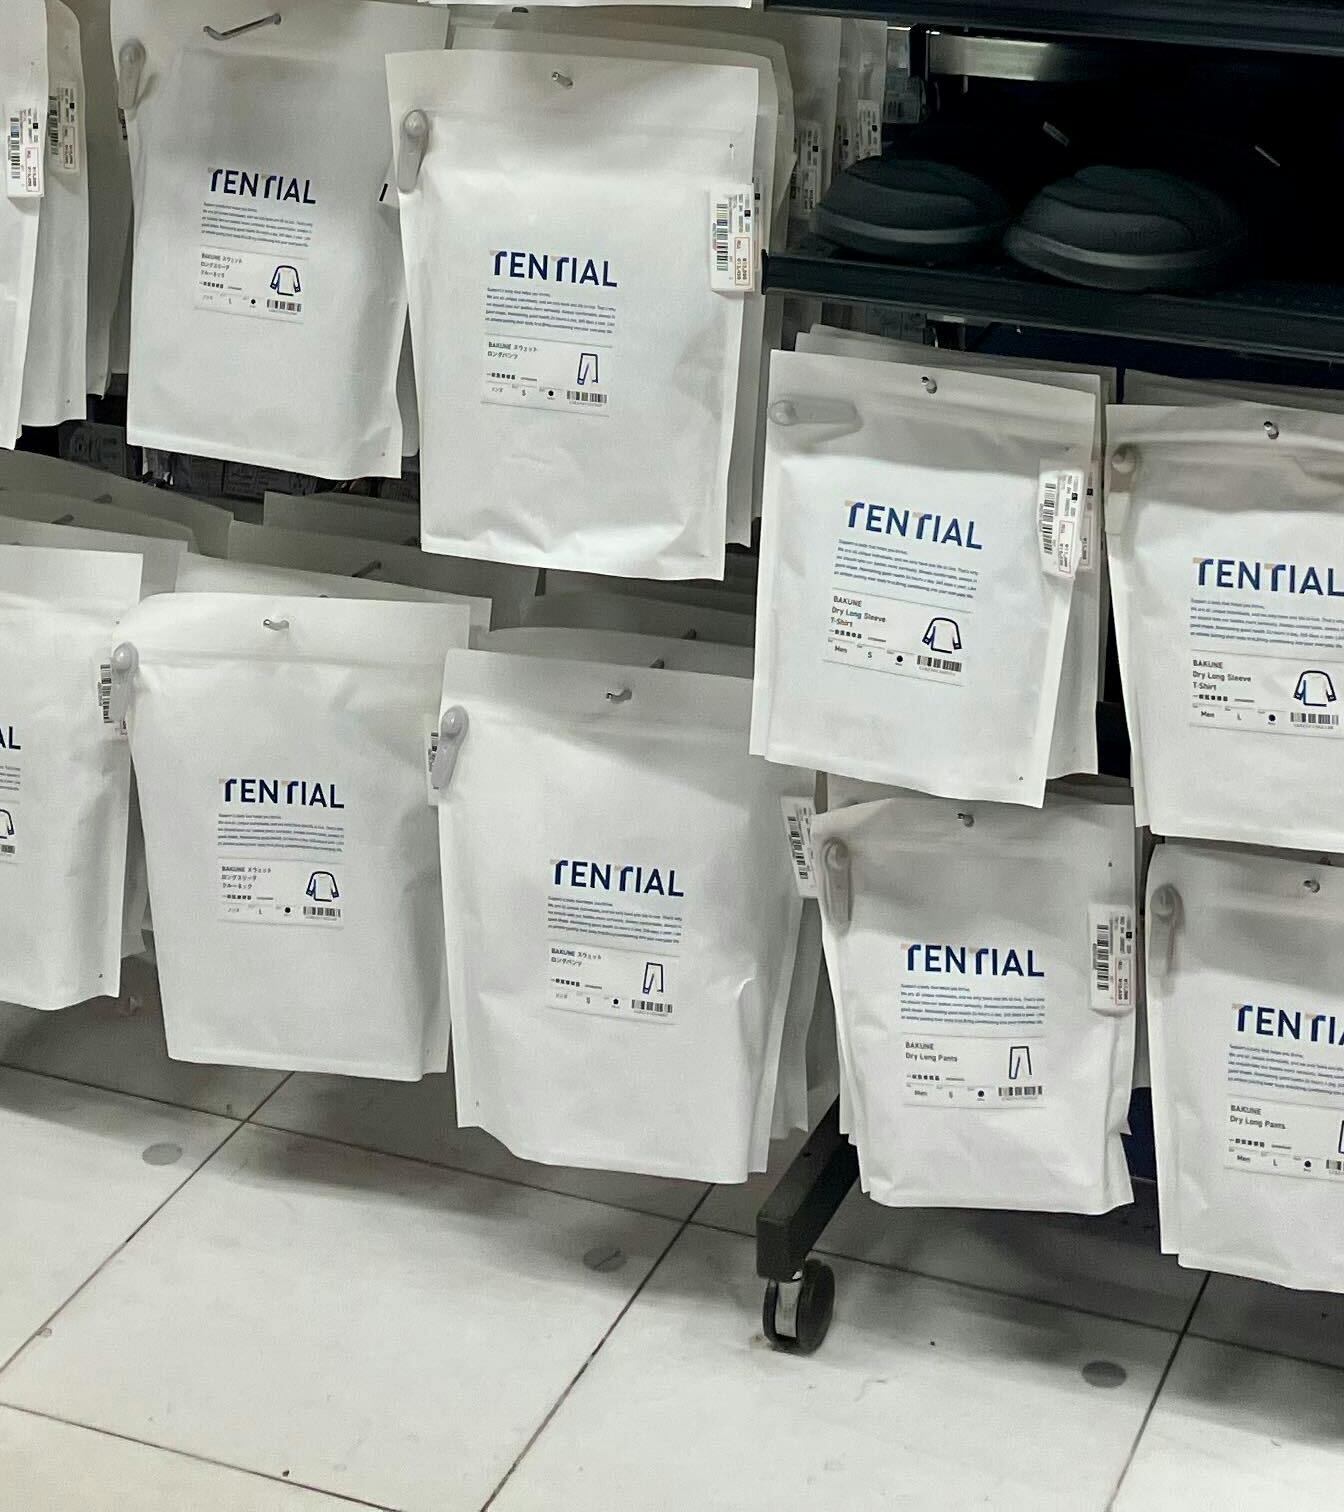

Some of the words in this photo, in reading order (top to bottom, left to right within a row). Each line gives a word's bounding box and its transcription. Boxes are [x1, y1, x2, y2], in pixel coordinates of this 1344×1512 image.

[208, 167, 317, 205] TENTIAL
[490, 249, 618, 289] TENTIAL
[845, 499, 983, 551] TENTIAL
[831, 606, 844, 618] Dry
[846, 609, 862, 621] Long
[864, 611, 887, 624] Sleeve
[833, 595, 863, 608] BAKUNE
[1192, 659, 1223, 669] BAKUNE
[1192, 670, 1206, 682] Dry
[1208, 672, 1225, 683] Long
[1227, 673, 1252, 683] Sleeve
[218, 777, 345, 810] TENTIAL
[551, 859, 685, 898] TENTIAL
[901, 942, 1046, 978] TENTIAL
